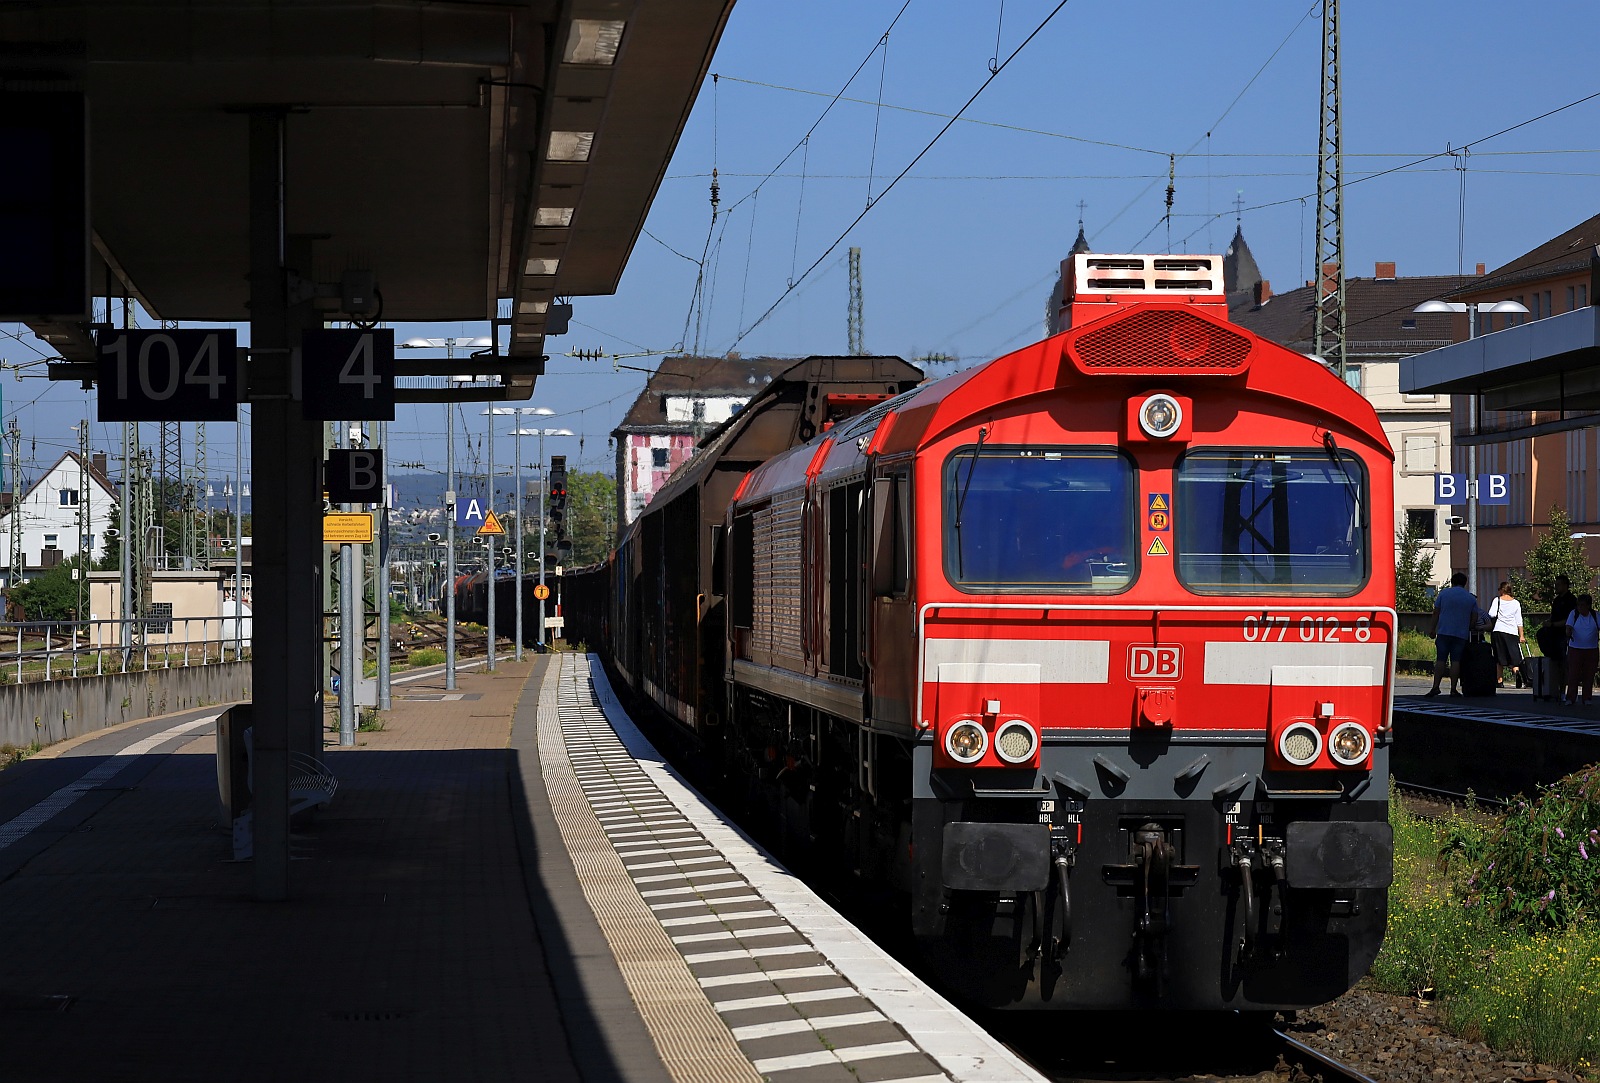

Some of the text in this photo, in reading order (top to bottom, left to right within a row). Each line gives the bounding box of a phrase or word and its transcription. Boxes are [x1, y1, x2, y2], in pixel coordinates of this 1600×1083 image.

[102, 333, 227, 401] 104
[338, 333, 382, 399] 4
[350, 452, 377, 491] B
[1438, 474, 1456, 498] B
[1489, 474, 1507, 498] B
[465, 498, 483, 520] A
[1243, 616, 1371, 642] 077 012-8
[1134, 650, 1176, 675] DB
[1041, 801, 1050, 811] CP
[1070, 801, 1079, 811] CG
[1038, 814, 1053, 823] HBL
[1067, 814, 1081, 823] HLL
[1225, 814, 1239, 823] HLL
